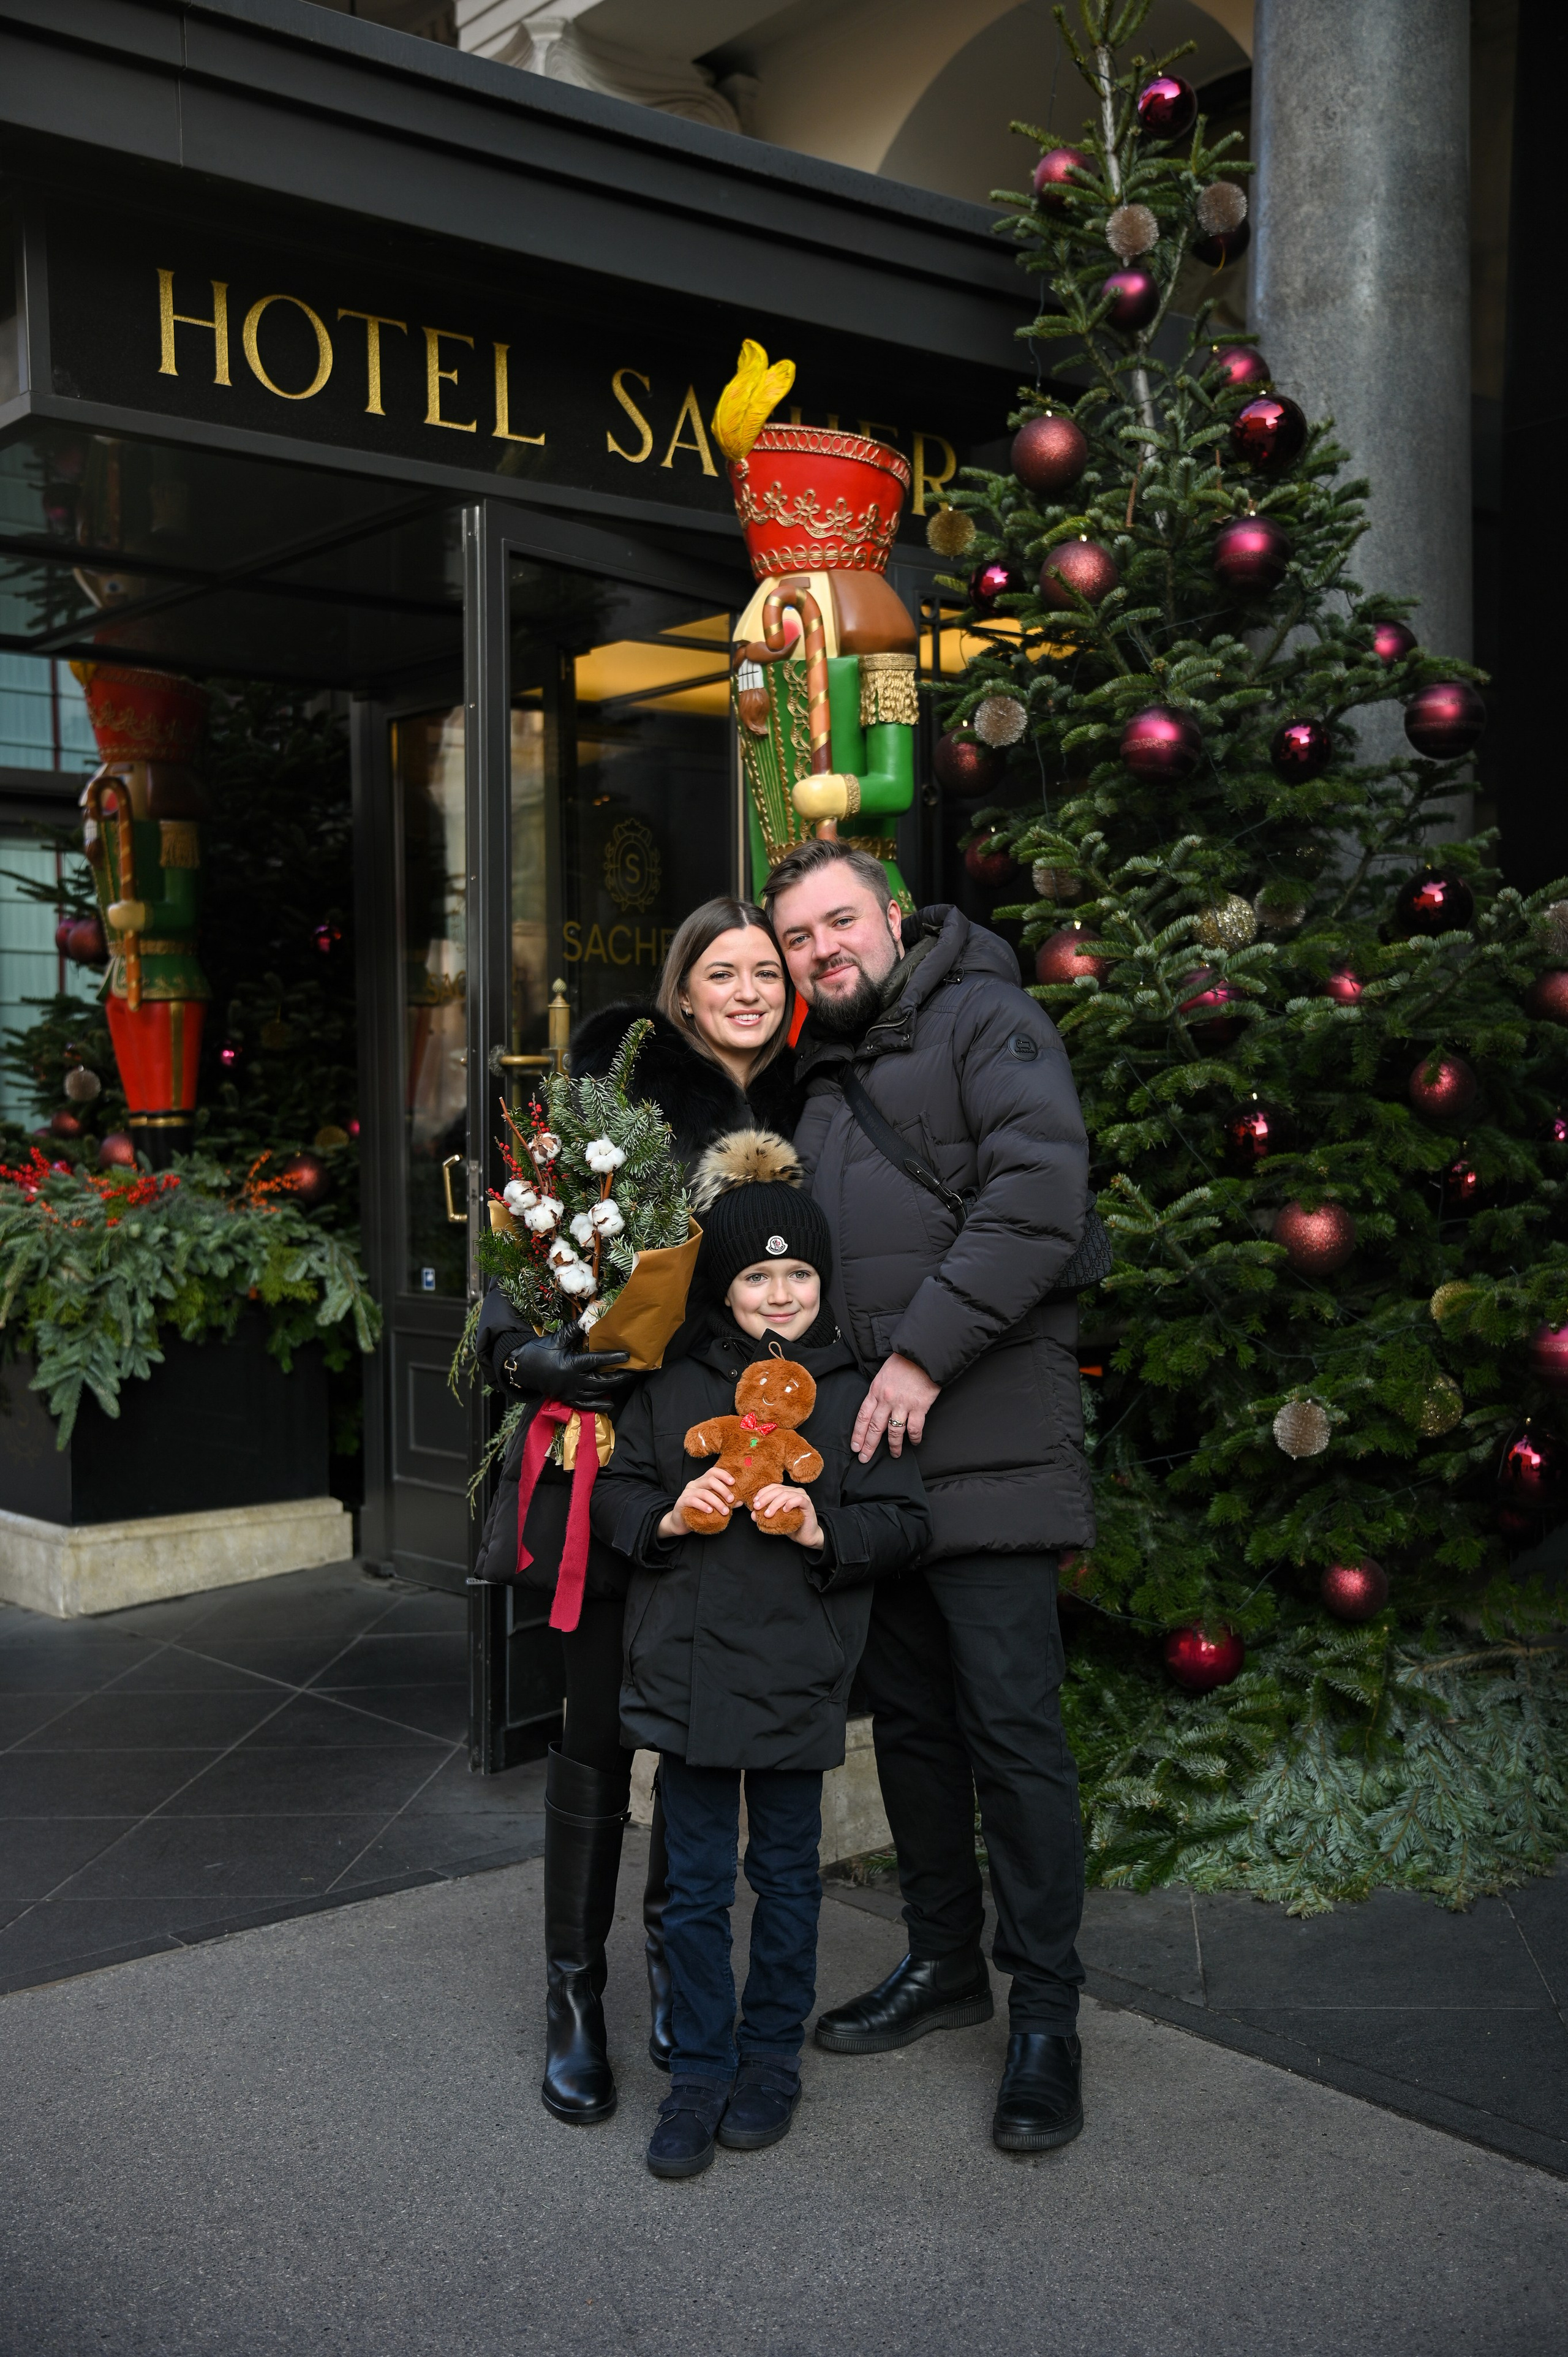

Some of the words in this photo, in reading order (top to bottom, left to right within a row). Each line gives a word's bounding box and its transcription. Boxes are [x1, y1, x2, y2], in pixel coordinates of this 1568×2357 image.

[156, 268, 546, 446] HOTEL
[606, 368, 957, 517] SAR
[625, 854, 641, 884] S
[562, 921, 675, 966] SACHE
